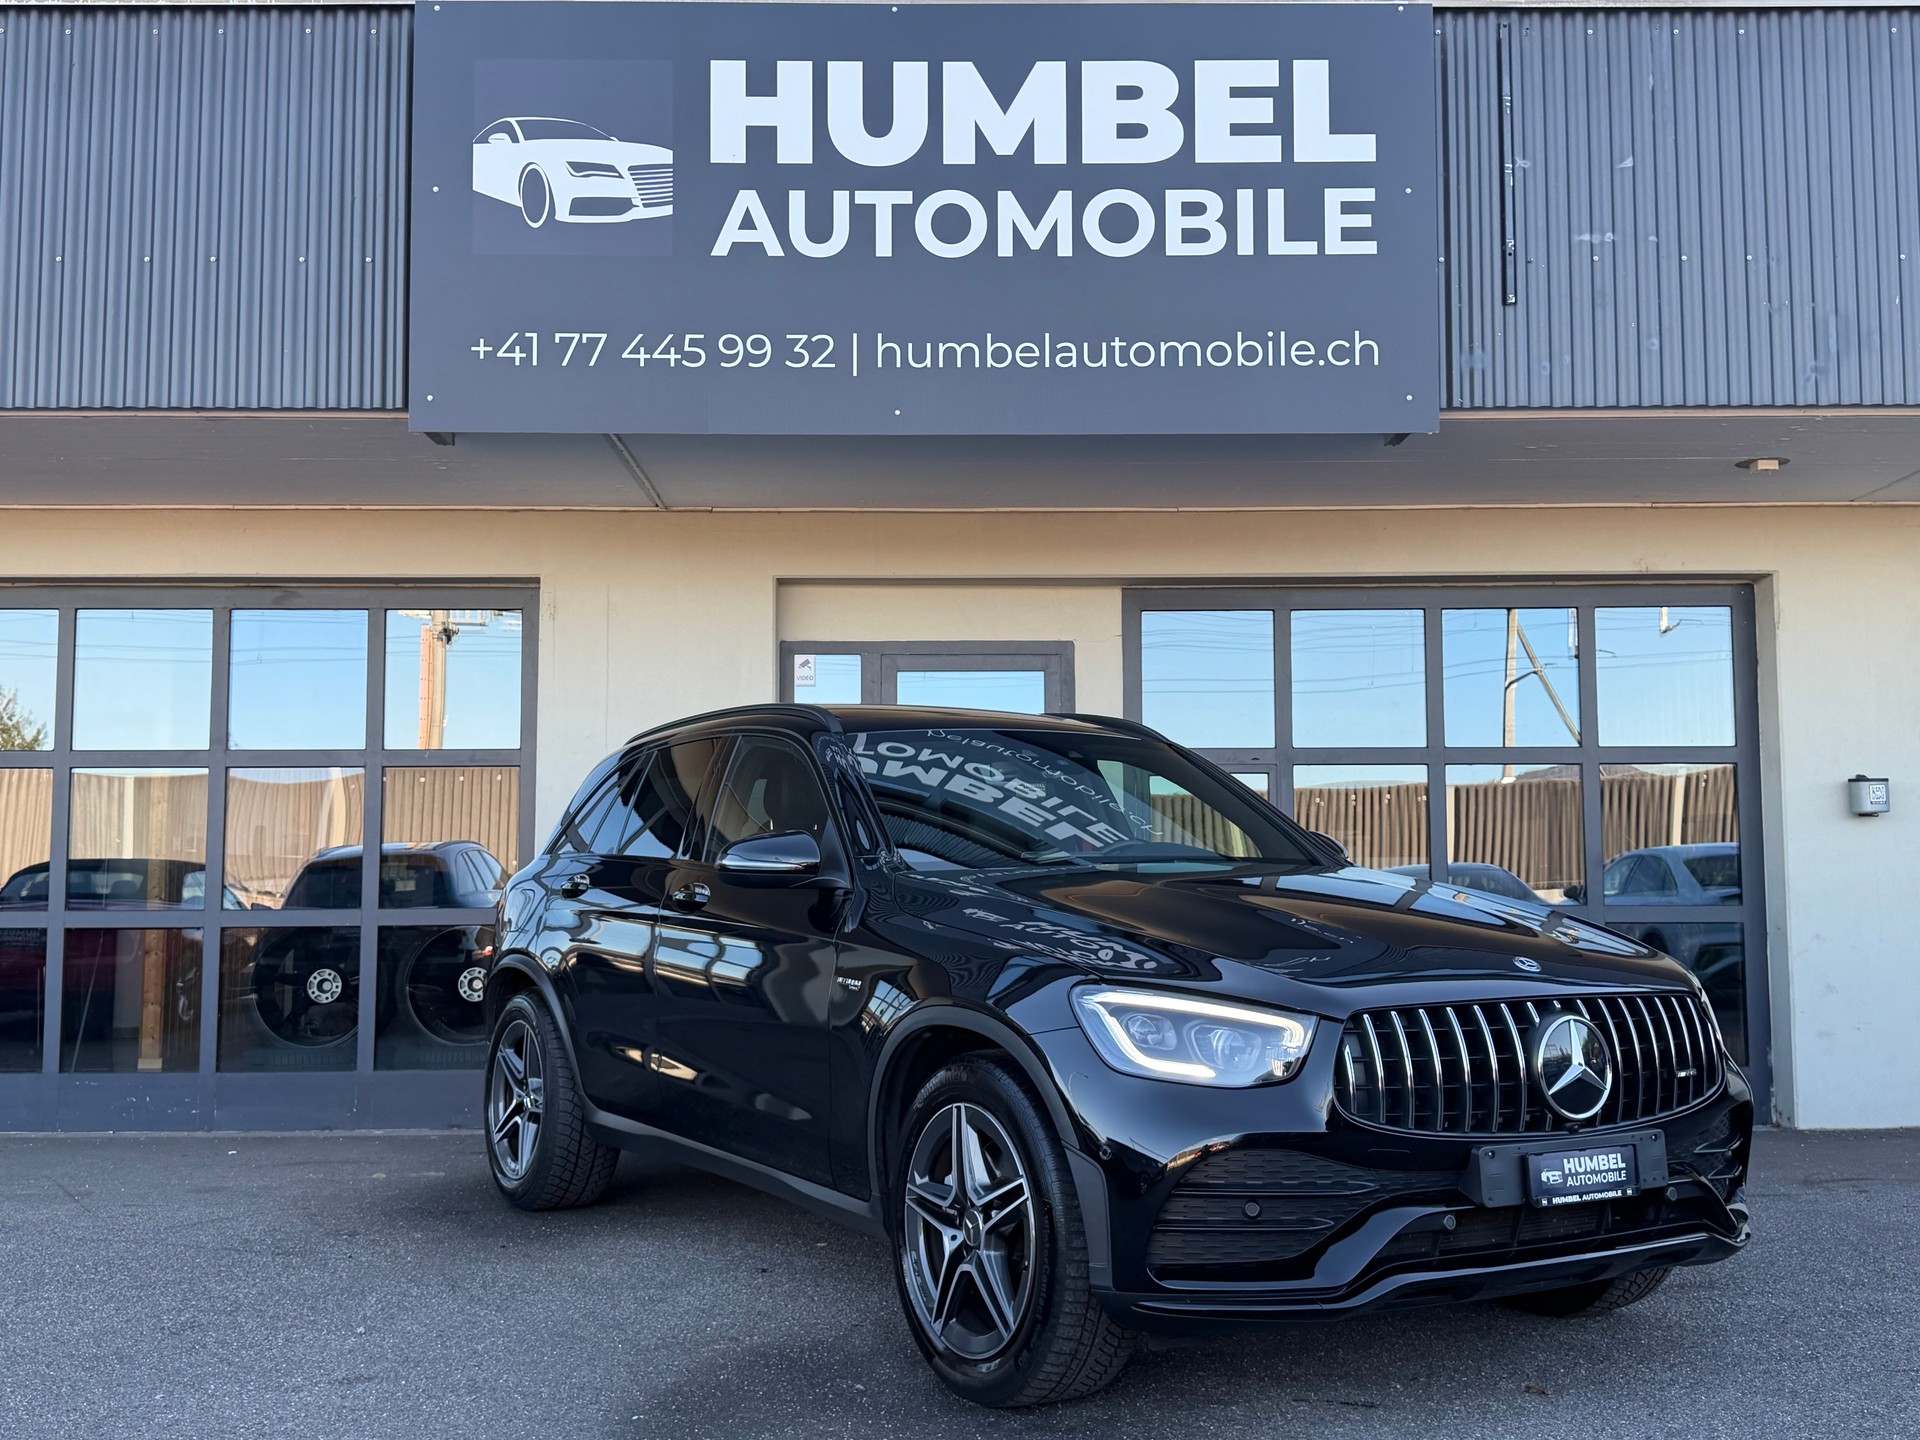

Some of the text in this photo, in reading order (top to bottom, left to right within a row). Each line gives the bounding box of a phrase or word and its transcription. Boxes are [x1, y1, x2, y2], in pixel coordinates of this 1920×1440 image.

[710, 60, 1377, 166] HUMBEL
[711, 188, 1378, 258] AUTOMOBILE
[471, 333, 538, 367] +41
[555, 333, 608, 367] 77
[622, 333, 706, 368] 445
[719, 333, 772, 368] 99
[785, 333, 836, 368] 32
[878, 331, 1379, 368] humbelautomobile.ch
[1563, 1153, 1626, 1174] HUMBEL
[1566, 1170, 1627, 1187] AUTOMOBILE
[1552, 1190, 1622, 1204] HUMBEL AUTOMOBILE
